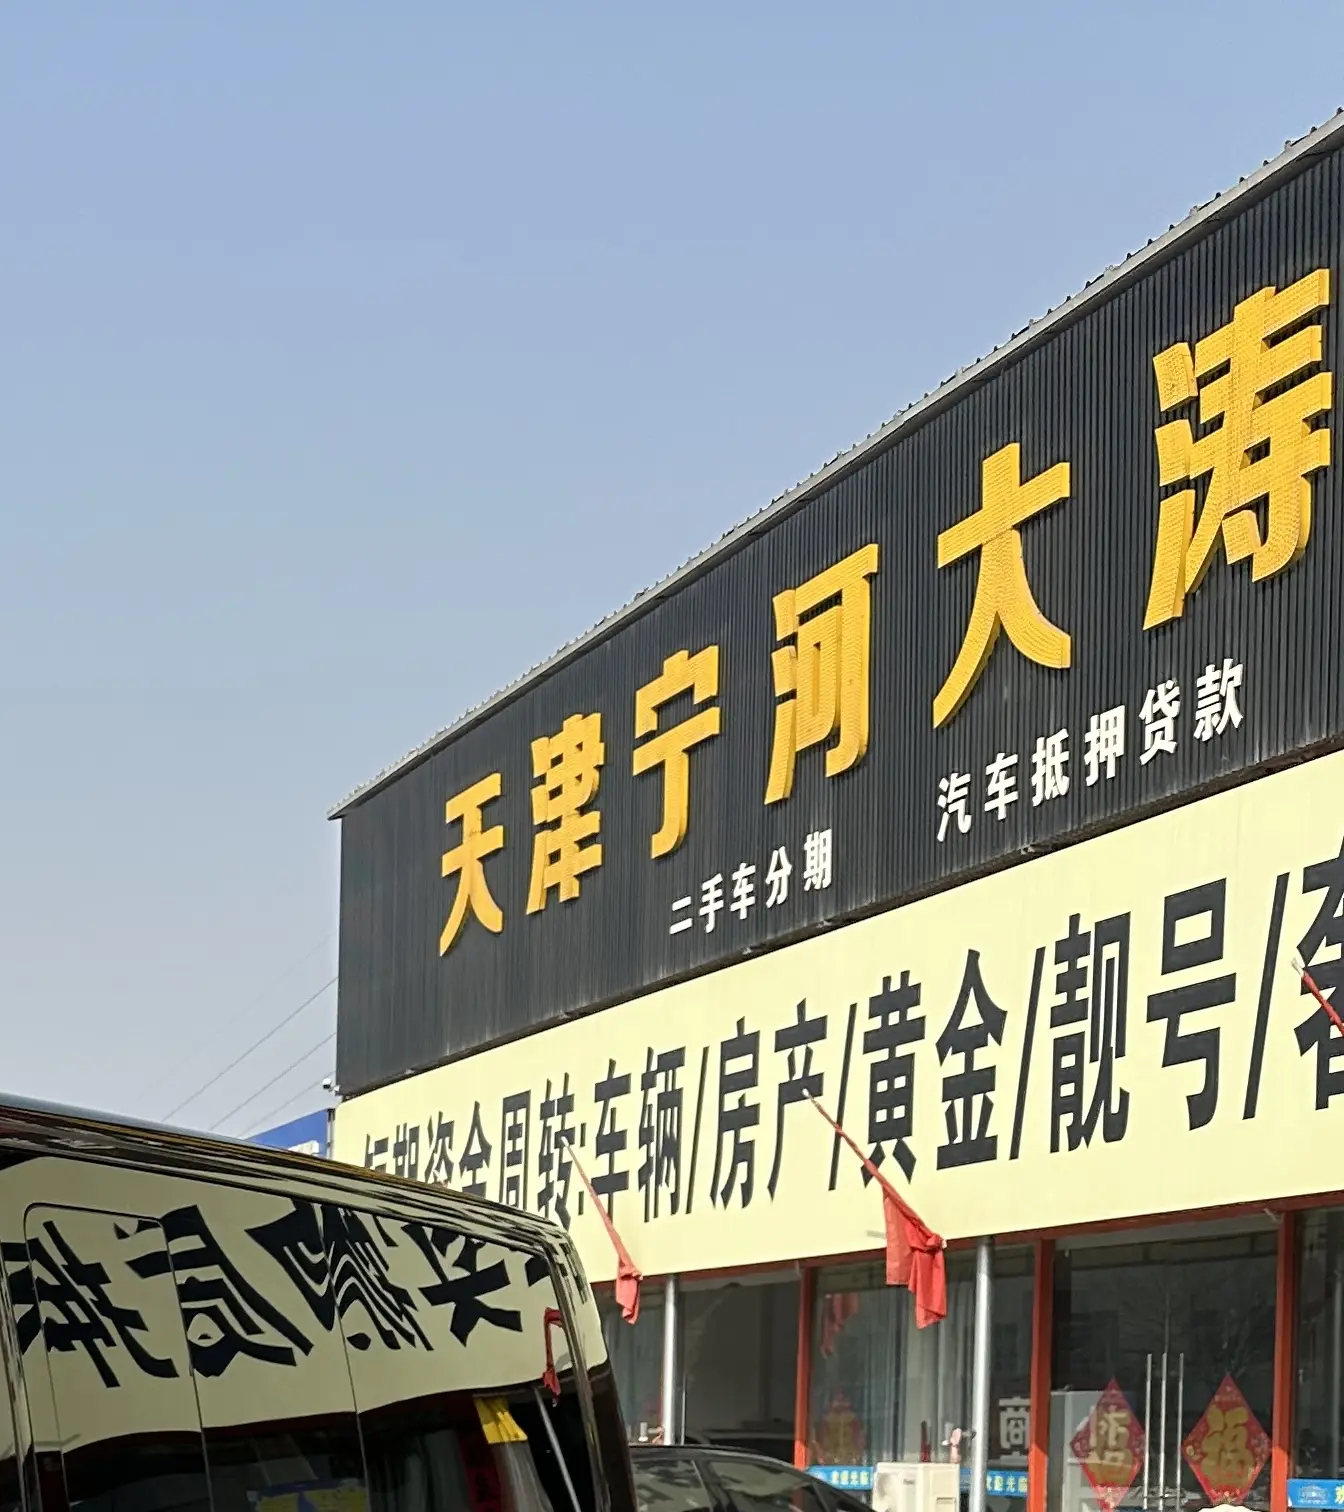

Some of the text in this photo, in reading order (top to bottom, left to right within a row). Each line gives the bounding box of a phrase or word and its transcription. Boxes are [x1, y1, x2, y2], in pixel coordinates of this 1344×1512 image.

[438, 266, 1334, 956] 天津宁河大涛
[936, 658, 1244, 842] 汽车抵押贷款
[669, 830, 834, 935] 二手车分期
[1200, 1404, 1255, 1486] 福
